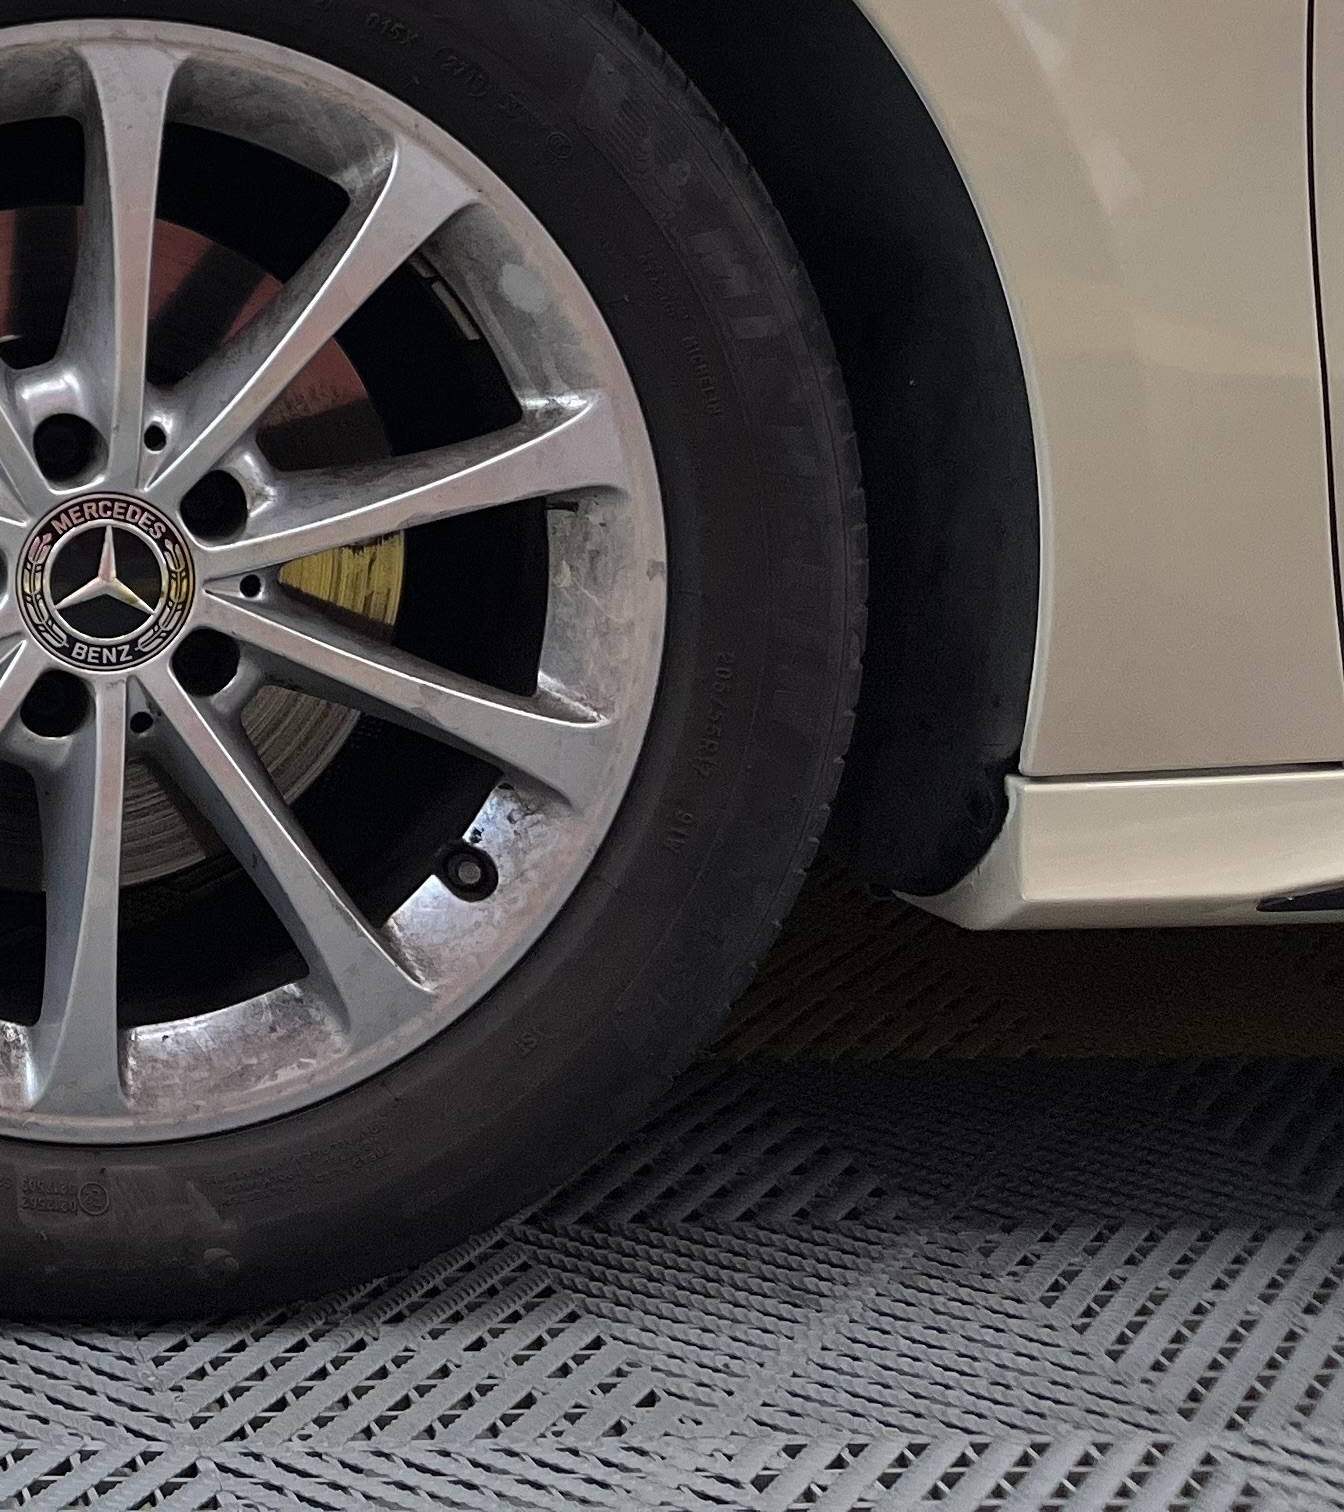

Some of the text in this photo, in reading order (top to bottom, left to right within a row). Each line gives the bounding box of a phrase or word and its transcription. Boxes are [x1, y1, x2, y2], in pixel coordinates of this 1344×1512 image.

[681, 333, 723, 417] MICHELIN
[50, 501, 167, 539] MERCEDES
[71, 643, 133, 664] BENZ
